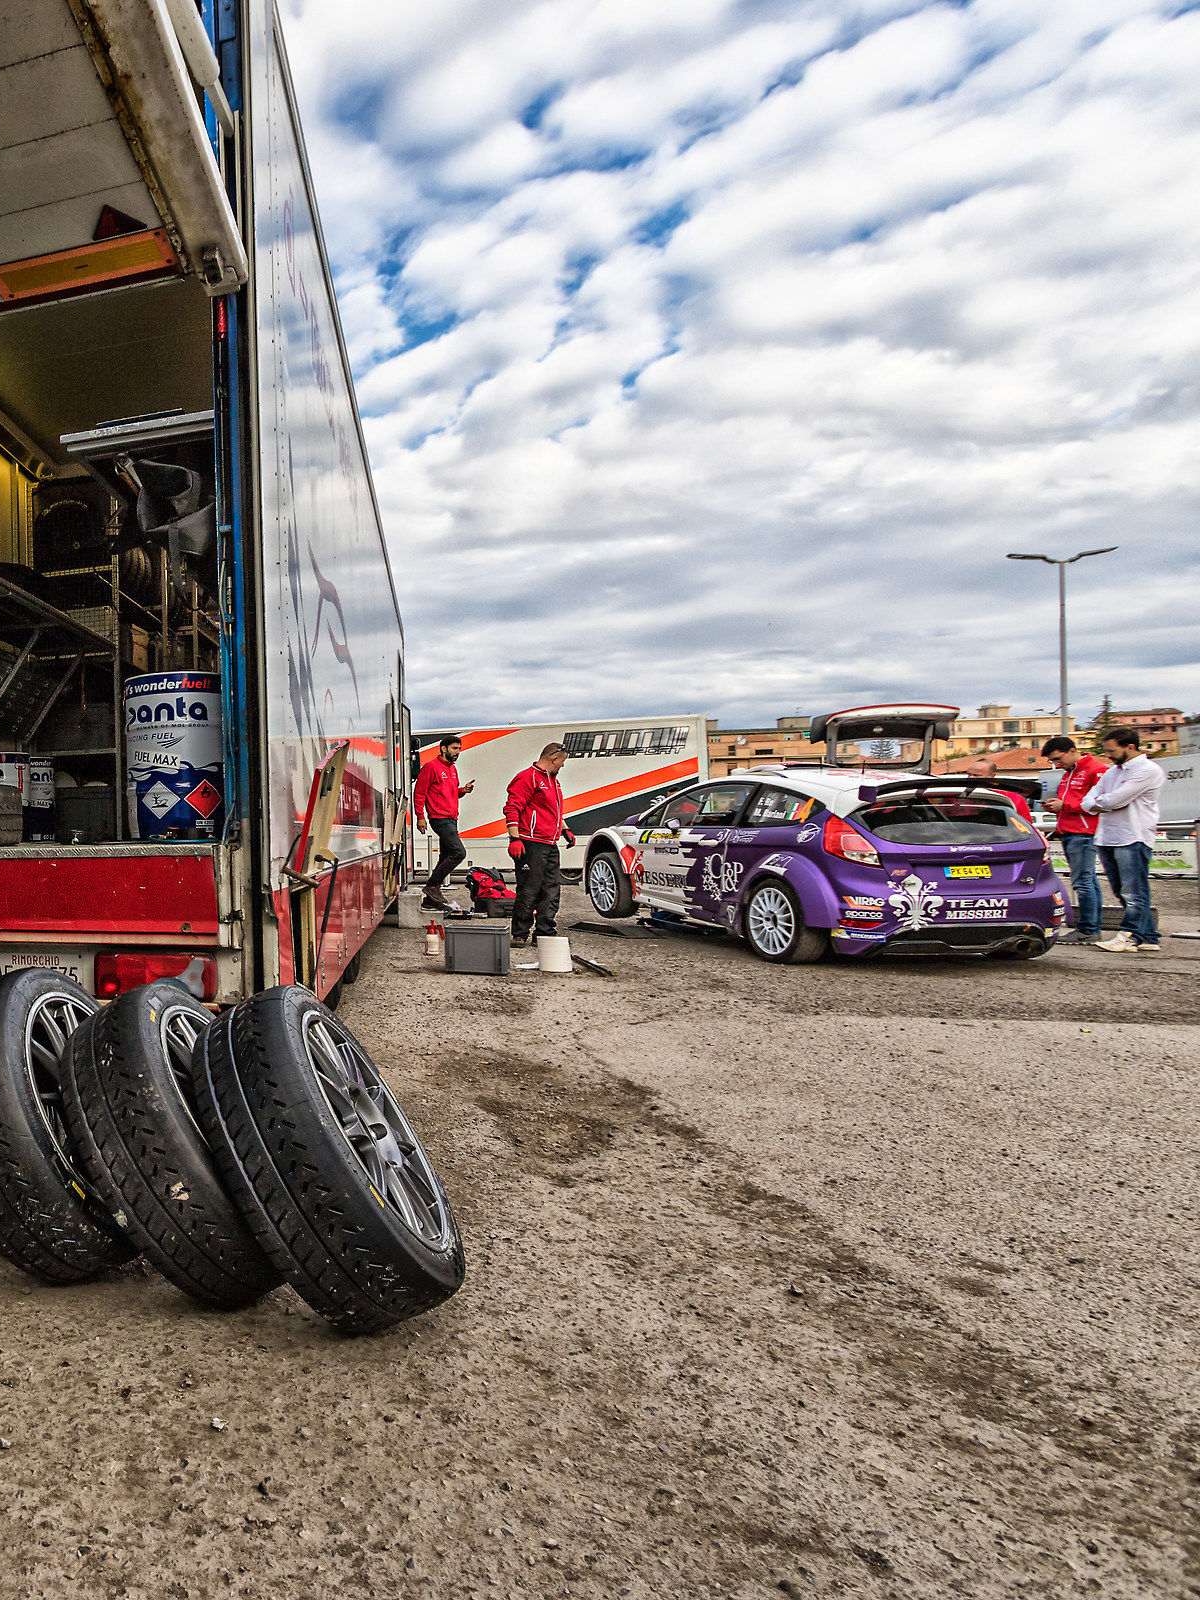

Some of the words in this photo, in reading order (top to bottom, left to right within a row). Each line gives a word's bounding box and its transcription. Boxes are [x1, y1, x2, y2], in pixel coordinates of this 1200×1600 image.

[151, 732, 176, 740] FUEL
[134, 751, 151, 763] FUEL
[153, 754, 179, 767] MAX
[800, 797, 816, 824] 4
[852, 896, 886, 907] VIRAG
[946, 898, 1008, 908] TEAM
[845, 911, 884, 920] sparco
[944, 909, 1008, 921] MESSERI
[11, 955, 60, 966] RIMORCHIO
